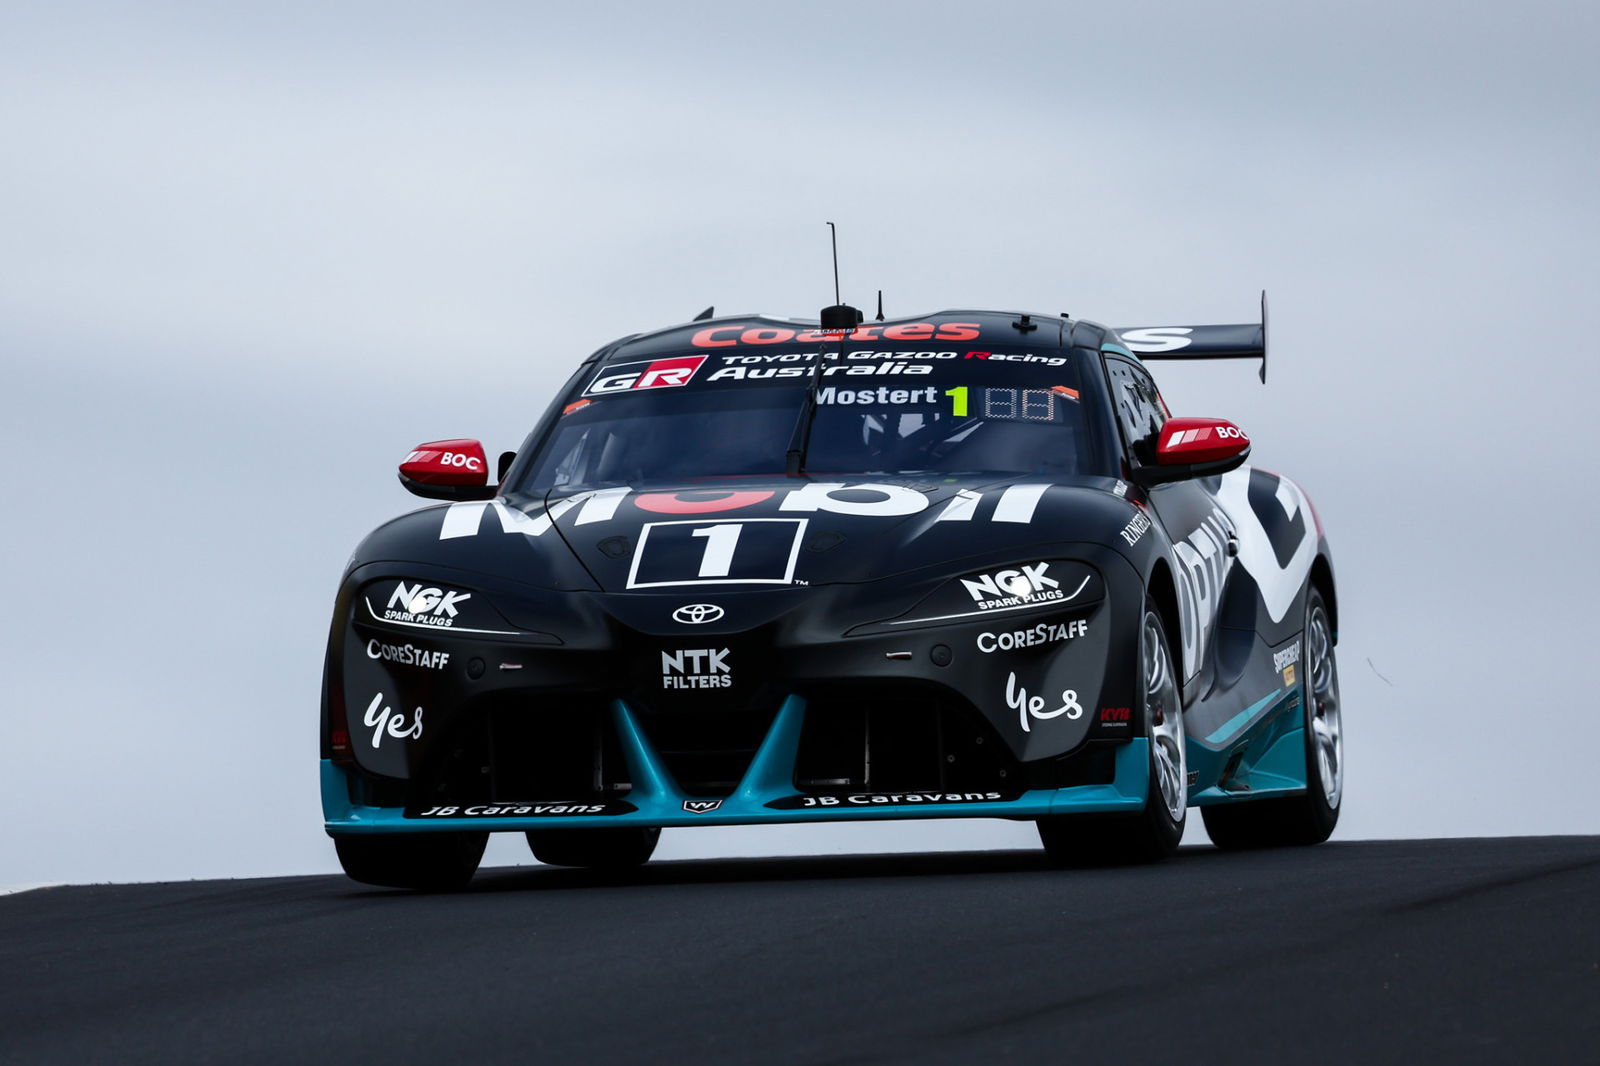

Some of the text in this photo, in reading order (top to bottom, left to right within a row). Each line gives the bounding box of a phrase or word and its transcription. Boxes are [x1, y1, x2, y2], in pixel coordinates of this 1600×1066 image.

[722, 351, 1067, 366] TOYOTA GAZOO Racing
[590, 368, 692, 393] GR
[706, 361, 934, 381] Australia
[815, 386, 968, 416] Mostert 1
[440, 452, 481, 471] BOC
[439, 482, 1055, 541] Mobil
[691, 523, 744, 577] 1
[960, 561, 1060, 602] NGK
[386, 580, 471, 618] NGK
[978, 589, 1064, 610] SPARK PLUGS
[384, 609, 453, 627] SPARK PLUGS
[661, 648, 731, 675] NTK
[663, 675, 732, 689] FILTERS
[421, 803, 605, 816] JB Caravans
[804, 792, 1001, 807] JB Caravans
